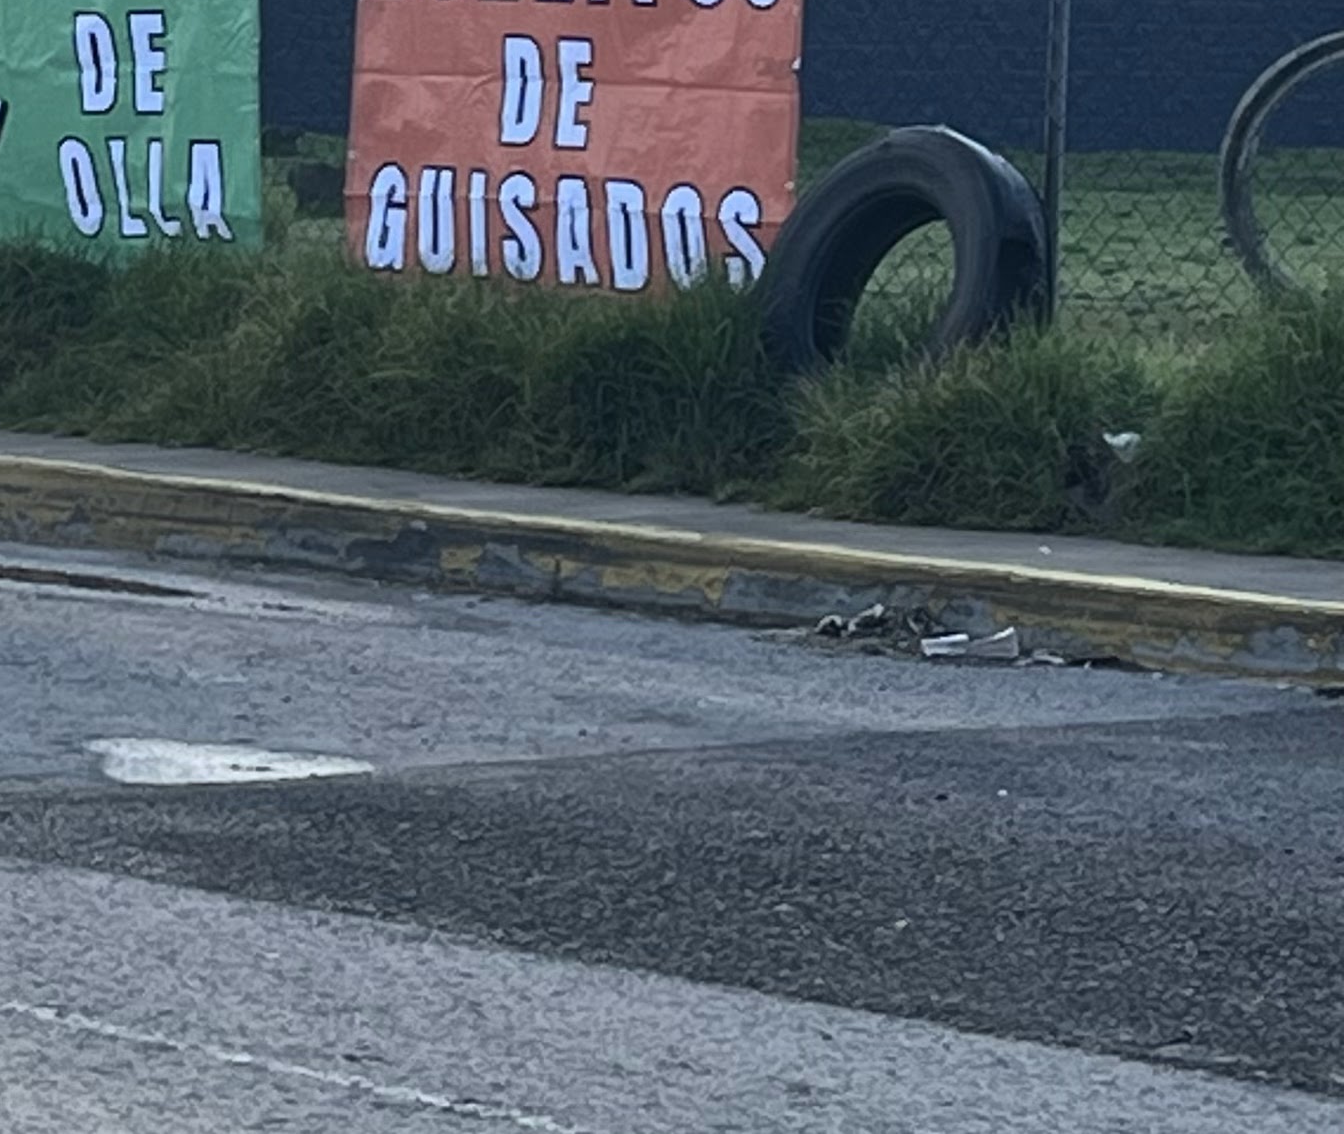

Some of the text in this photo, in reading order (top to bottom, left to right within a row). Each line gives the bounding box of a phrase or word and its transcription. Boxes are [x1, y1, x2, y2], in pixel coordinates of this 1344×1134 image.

[74, 12, 168, 114] DE
[499, 34, 596, 151] DE
[56, 137, 234, 242] OLLA
[364, 163, 768, 293] GUISADOS
